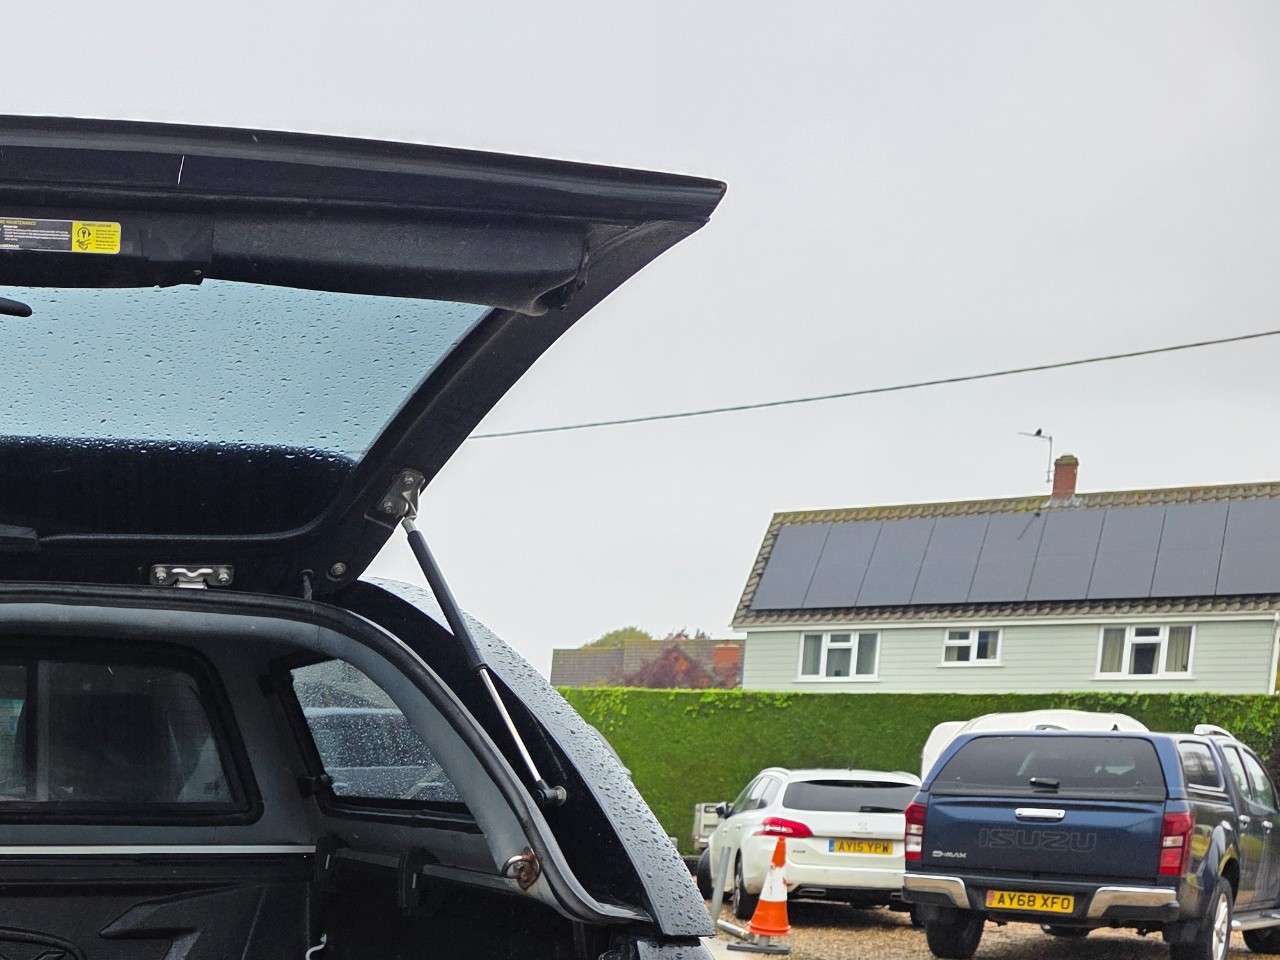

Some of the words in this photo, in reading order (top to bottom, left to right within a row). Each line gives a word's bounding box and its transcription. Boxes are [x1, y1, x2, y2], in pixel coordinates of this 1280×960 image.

[838, 841, 864, 851] AY15
[865, 841, 889, 852] YPW
[979, 828, 1097, 851] ISUZU
[997, 892, 1034, 907] AY68
[1039, 896, 1070, 910] XFO
